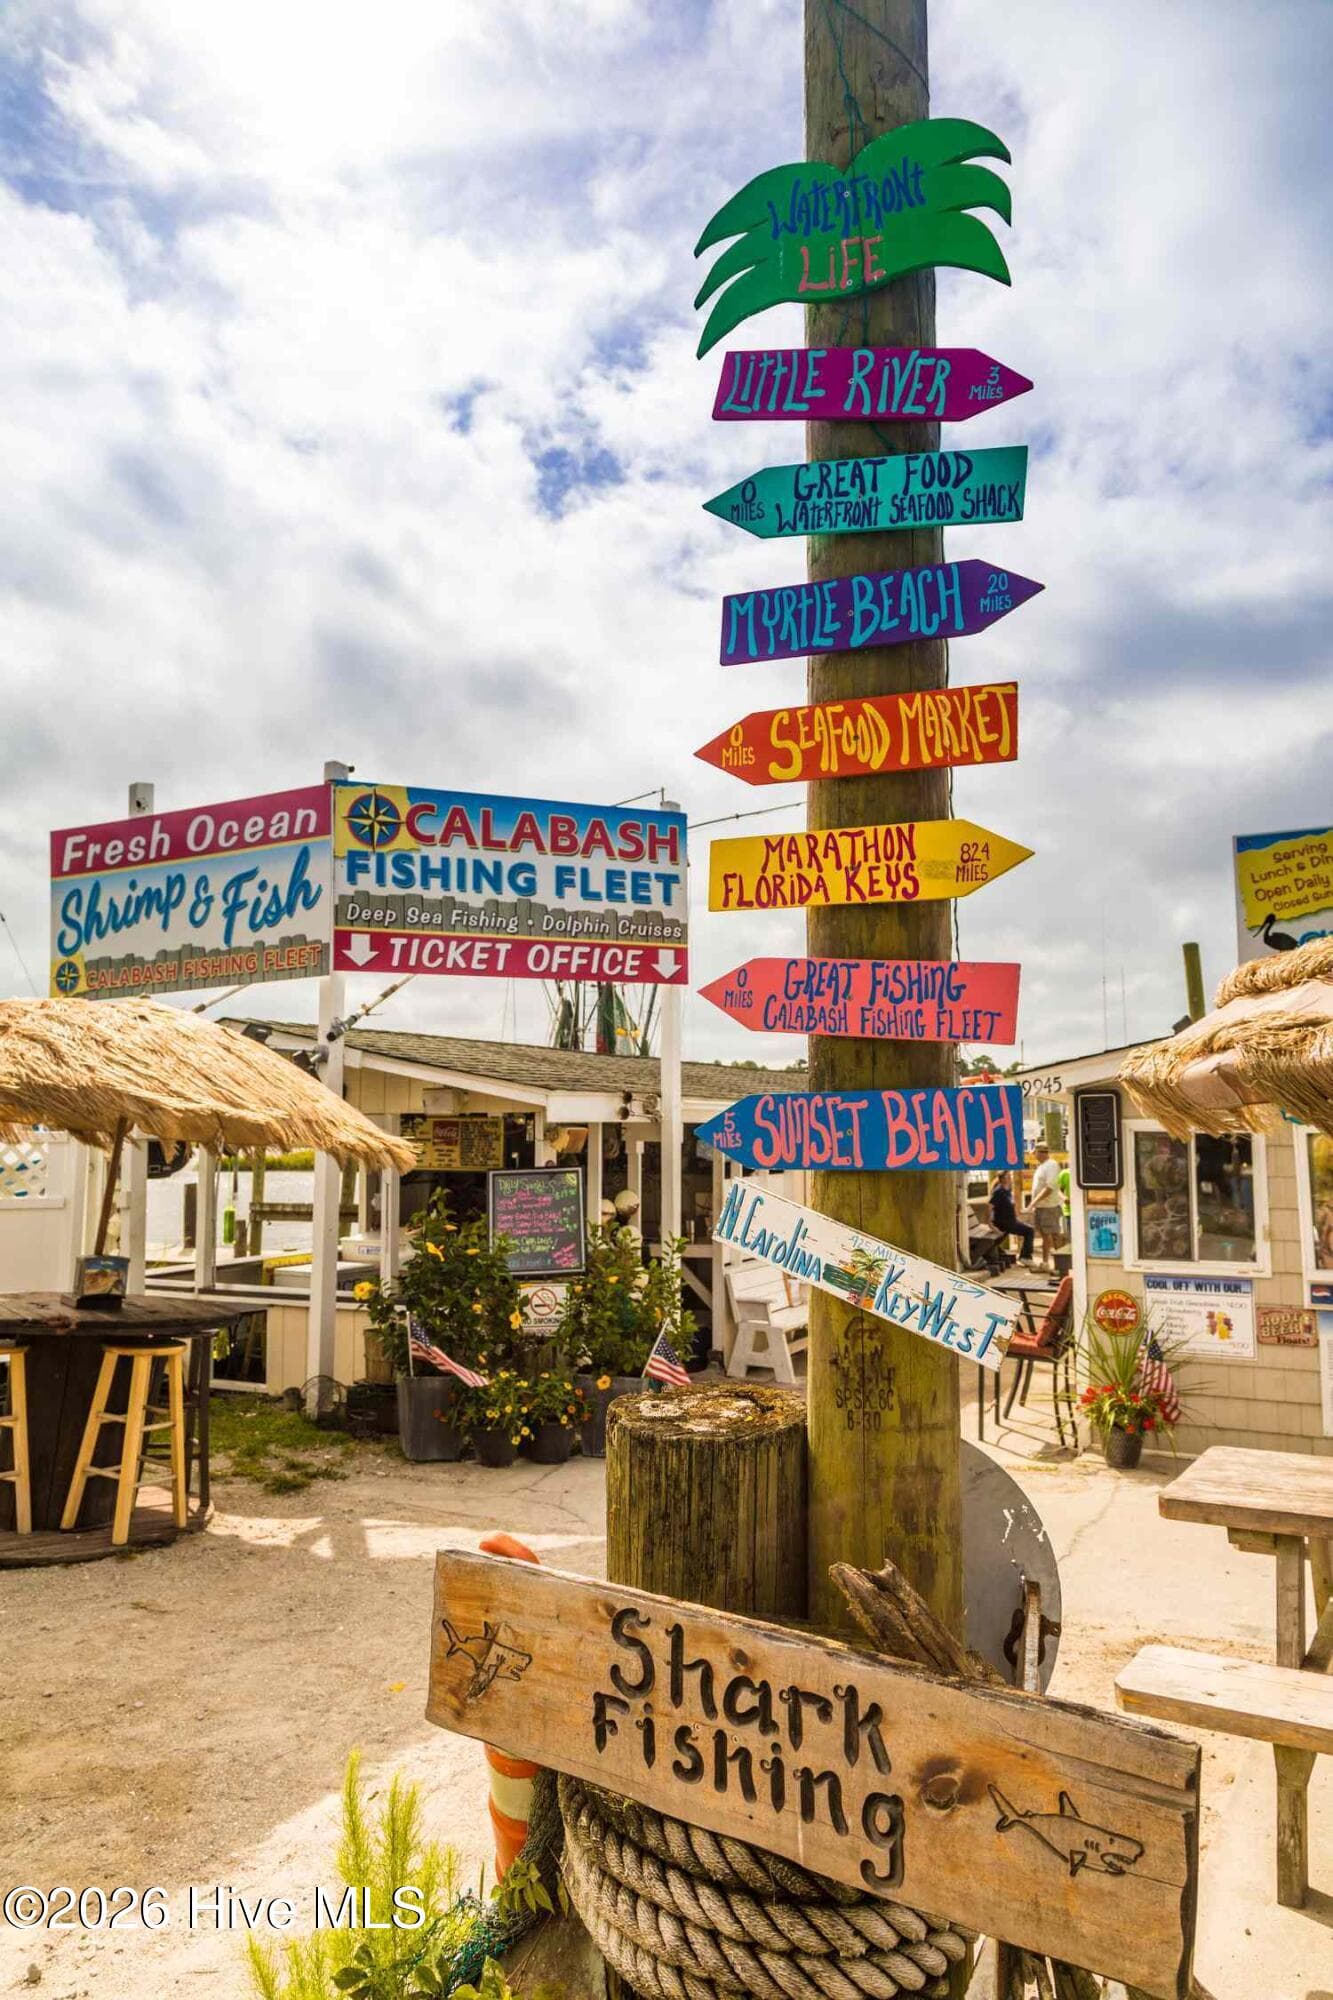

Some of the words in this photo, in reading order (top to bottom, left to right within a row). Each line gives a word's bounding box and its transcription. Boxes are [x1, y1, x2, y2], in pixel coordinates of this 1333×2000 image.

[987, 366, 1000, 383] 3
[794, 458, 887, 502] GREAT
[902, 450, 973, 496] FOOD
[889, 491, 954, 525] SEAFOOD
[961, 480, 1021, 520] SHACK
[987, 572, 1009, 595] 20
[726, 580, 841, 657] MYRTLE
[850, 563, 964, 648] BEACH
[768, 702, 891, 780] SEAFOOD
[898, 685, 1018, 766] MARKET
[62, 820, 170, 872] Fresh
[186, 808, 318, 852] Ocean
[405, 802, 680, 866] CALABASH
[761, 823, 917, 873] MARATHON
[960, 842, 990, 863] 824
[1273, 843, 1328, 863] Serving
[346, 850, 539, 897] FISHING
[554, 864, 681, 906] FLEET
[845, 861, 920, 900] KEYS
[1250, 864, 1292, 884] Lunch
[1296, 862, 1306, 871] &
[1255, 885, 1292, 901] Open
[1294, 874, 1330, 891] Daily
[57, 873, 186, 957] Shrimp
[189, 874, 214, 928] &
[221, 845, 322, 947] Fish
[346, 903, 397, 928] Deep
[406, 906, 443, 926] Sea
[450, 909, 519, 934] Fishing
[542, 915, 610, 938] Dolphin
[617, 920, 682, 939] Cruises
[1273, 895, 1310, 911] Closed
[85, 966, 177, 989] CALABASH
[183, 953, 257, 979] FISHING
[264, 944, 321, 970] FLEET
[389, 938, 512, 972] TICKET
[527, 944, 643, 976] OFFICE
[783, 959, 861, 1006] GREAT
[763, 995, 848, 1033] CALABASH
[935, 1007, 1003, 1041] FLEET
[1022, 1076, 1062, 1098] 9945
[723, 1112, 736, 1132] 5
[881, 1086, 1019, 1169] BEACH
[1090, 1215, 1117, 1230] COFFEE
[1146, 1279, 1168, 1290] COOL
[1173, 1280, 1190, 1291] OFF
[1194, 1280, 1221, 1293] WITH
[1263, 1312, 1299, 1325] ROOT
[610, 1606, 892, 1776] Shark
[592, 1691, 906, 1890] Fishing
